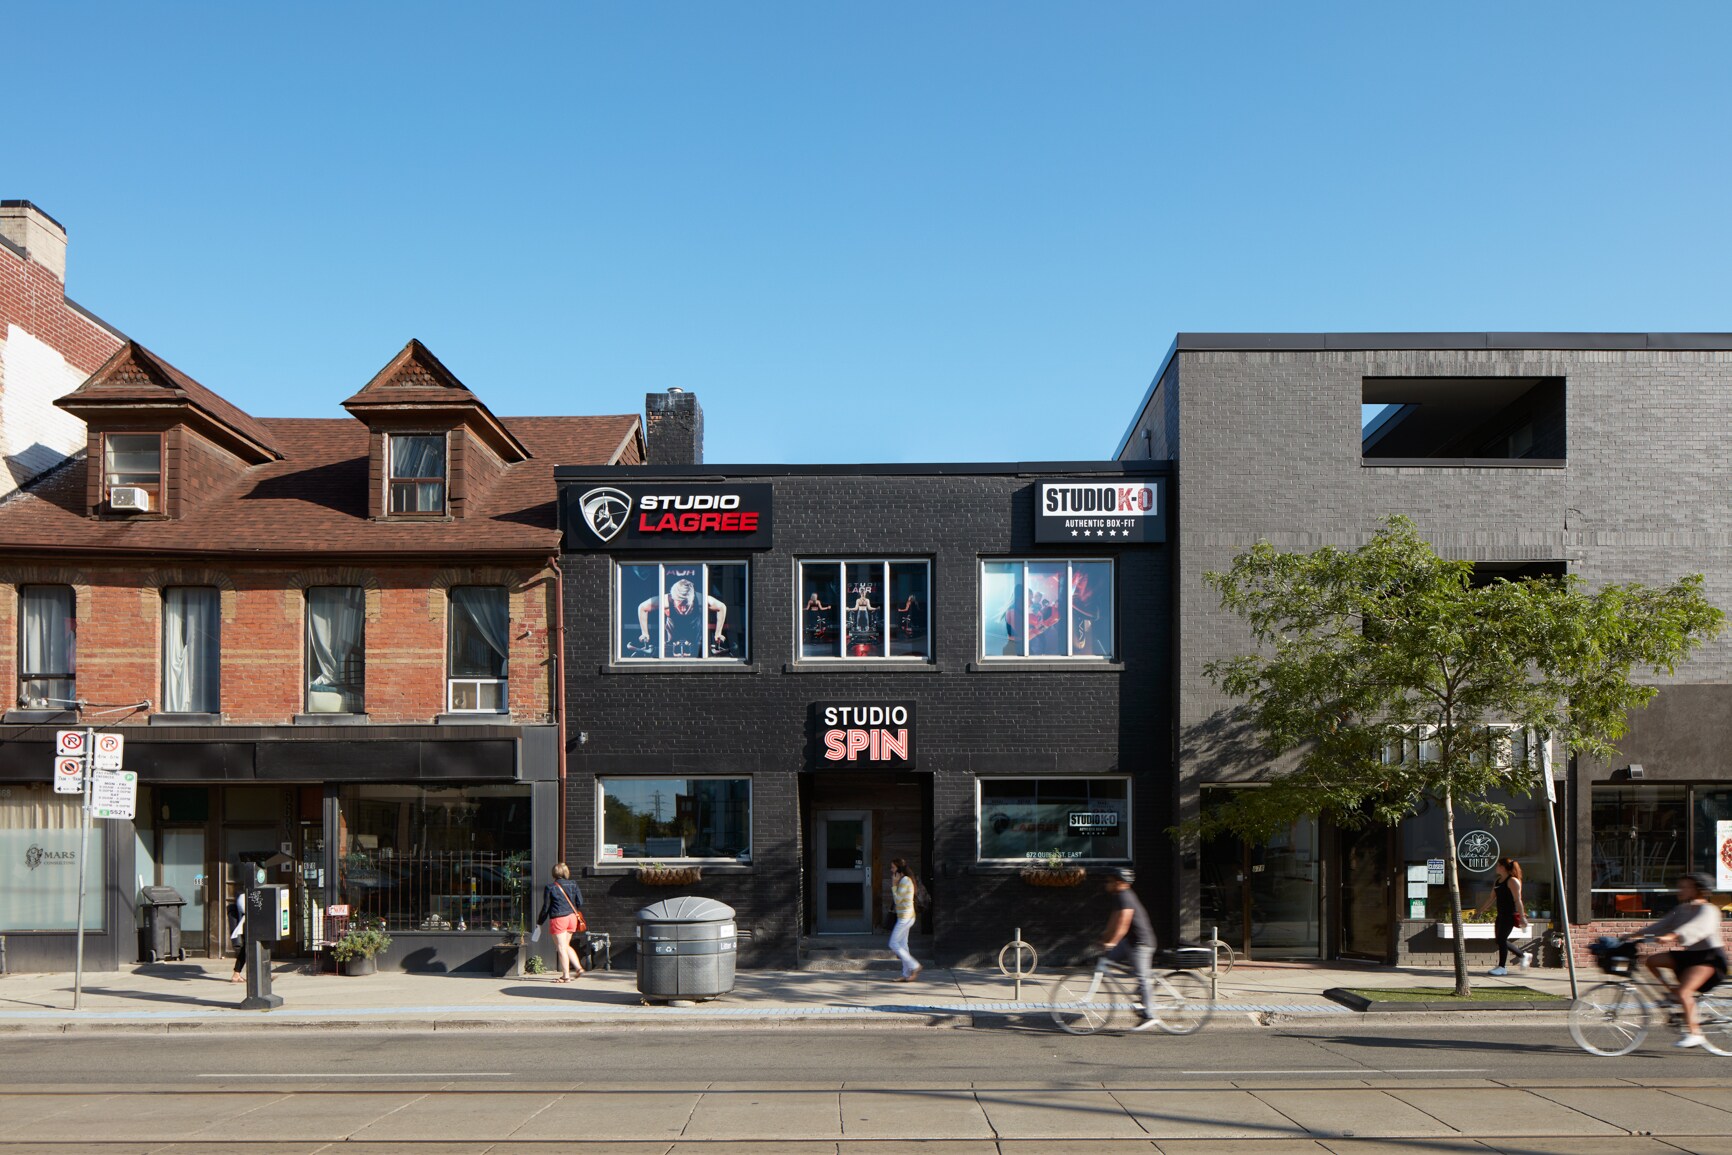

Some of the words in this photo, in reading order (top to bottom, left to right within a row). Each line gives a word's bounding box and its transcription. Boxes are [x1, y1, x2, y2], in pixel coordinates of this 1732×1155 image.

[640, 495, 740, 510] STUDIO
[639, 512, 759, 531] LAGREE
[1065, 519, 1104, 527] AUTHENTIC
[1106, 519, 1135, 527] BOX-FIT
[825, 706, 908, 726] STUDIO
[824, 729, 908, 761] SPIN
[0, 789, 12, 798] 68
[44, 851, 76, 859] MARS
[1468, 858, 1490, 868] DINER
